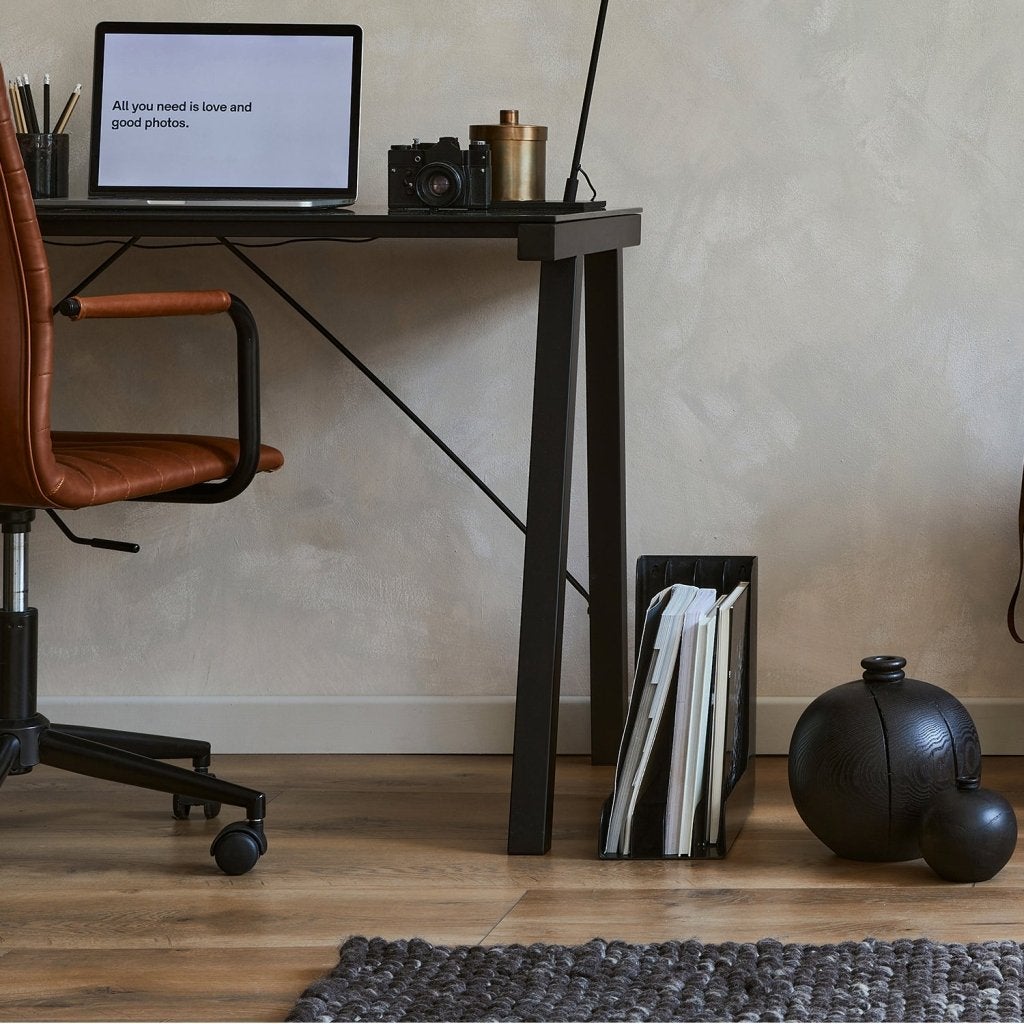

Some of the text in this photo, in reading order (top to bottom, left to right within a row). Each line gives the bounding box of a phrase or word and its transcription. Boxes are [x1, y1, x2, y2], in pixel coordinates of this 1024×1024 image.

[112, 100, 252, 114] All you need is love and
[111, 116, 189, 130] good photos.
